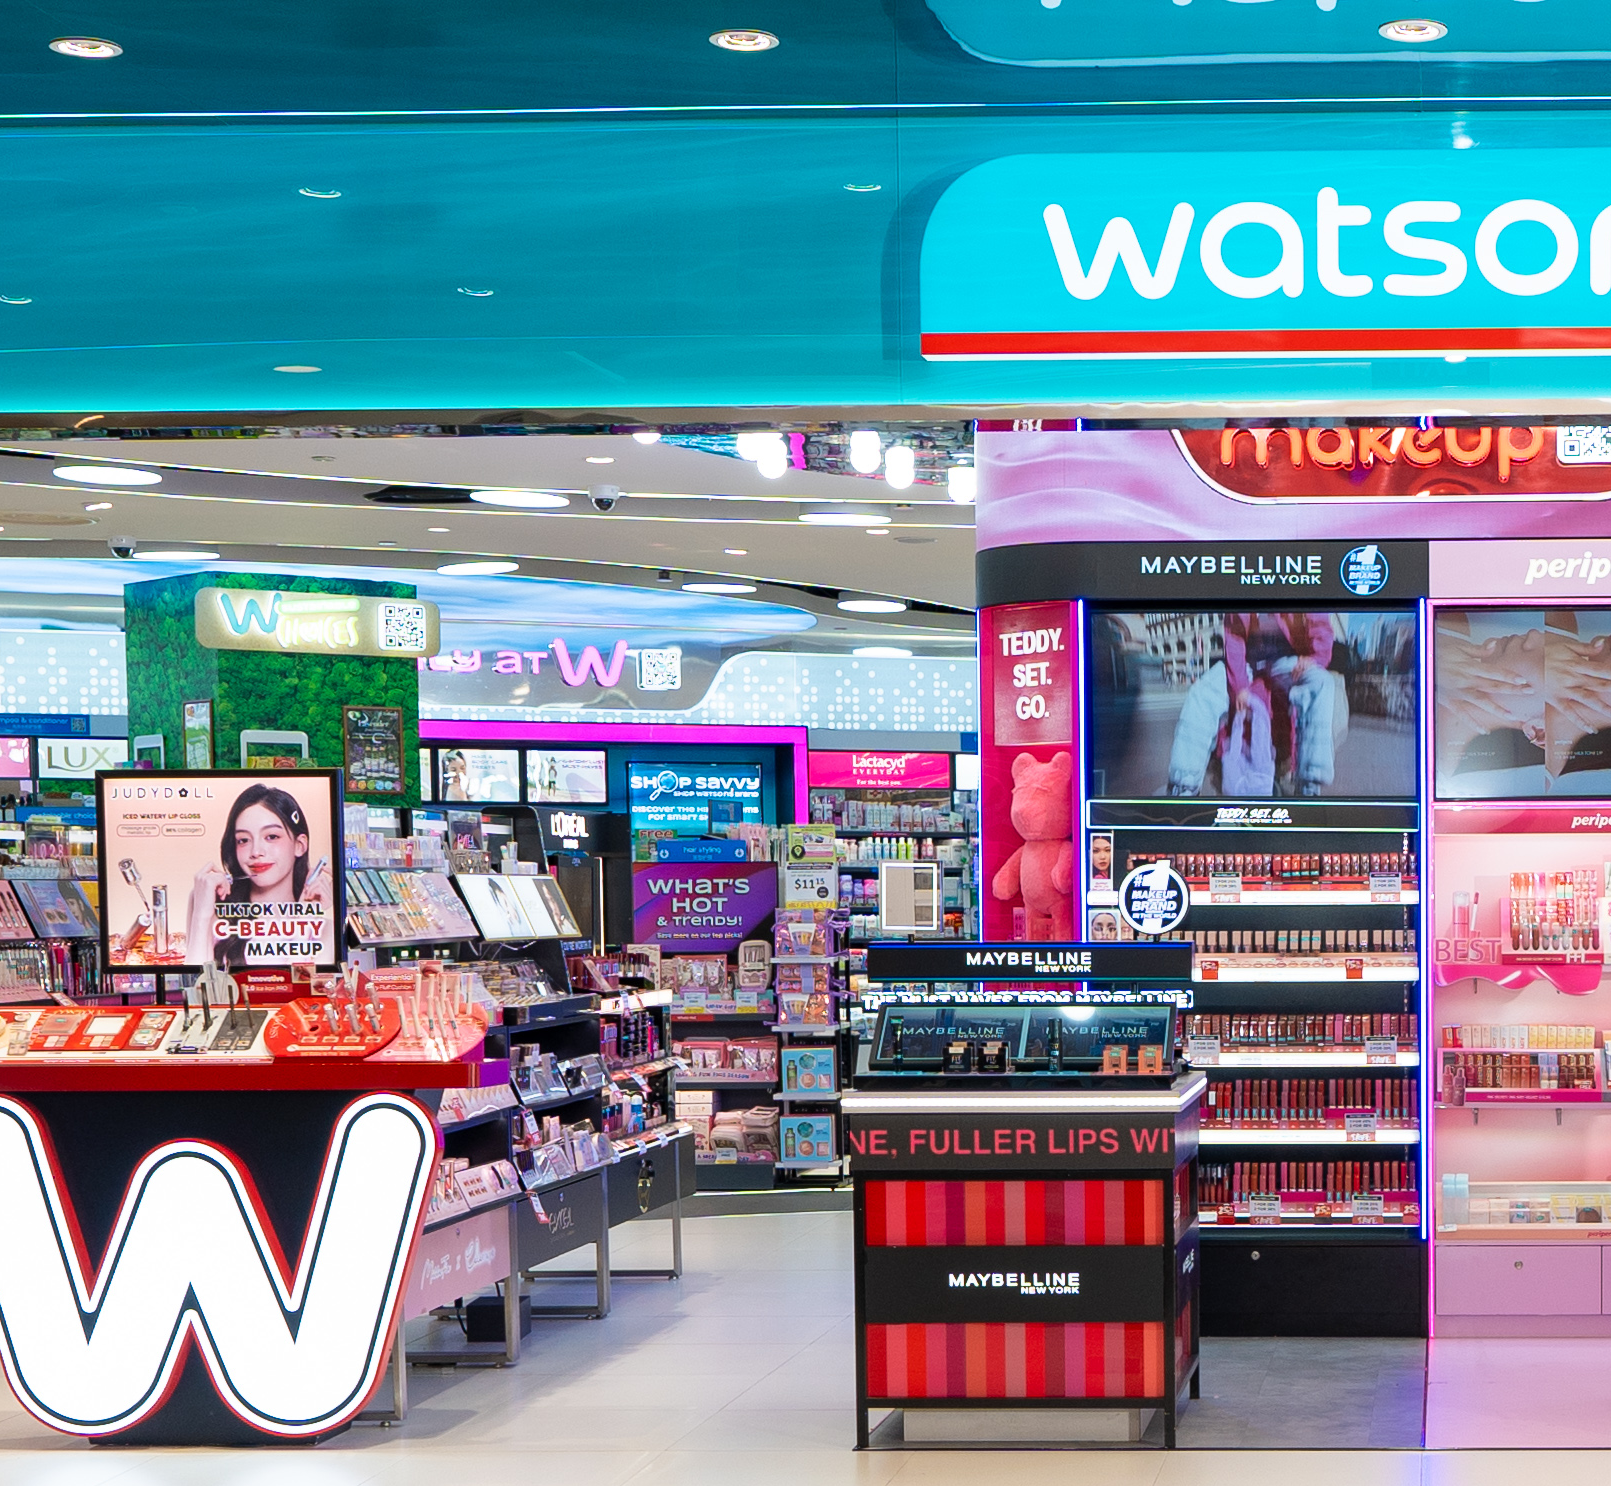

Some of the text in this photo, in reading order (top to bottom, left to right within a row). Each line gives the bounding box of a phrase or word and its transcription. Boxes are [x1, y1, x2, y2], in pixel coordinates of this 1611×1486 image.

[1141, 556, 1322, 573] MAYBELLINE
[1240, 575, 1322, 584] NEW YORK
[217, 593, 282, 635] W
[999, 628, 1065, 656] TEDDY.
[554, 639, 628, 687] W
[1012, 662, 1053, 688] SET.
[1015, 696, 1050, 720] GO.
[47, 747, 114, 768] LUX
[852, 754, 906, 770] Lactacyd
[701, 846, 722, 855] styling
[1131, 890, 1177, 900] MAKEUP
[216, 904, 324, 917] TIKTOK VIRAL
[672, 897, 728, 913] HOT
[1131, 900, 1176, 911] BRAND
[657, 916, 668, 926] &
[214, 922, 323, 937] C-BEAUTY
[247, 942, 323, 956] MAKEUP
[1435, 938, 1501, 964] BEST
[966, 952, 1092, 966] MAYBELLINE
[910, 1128, 1036, 1155] FULLER
[1049, 1128, 1120, 1154] LIPS
[949, 1273, 1080, 1287] MAYBELLINE
